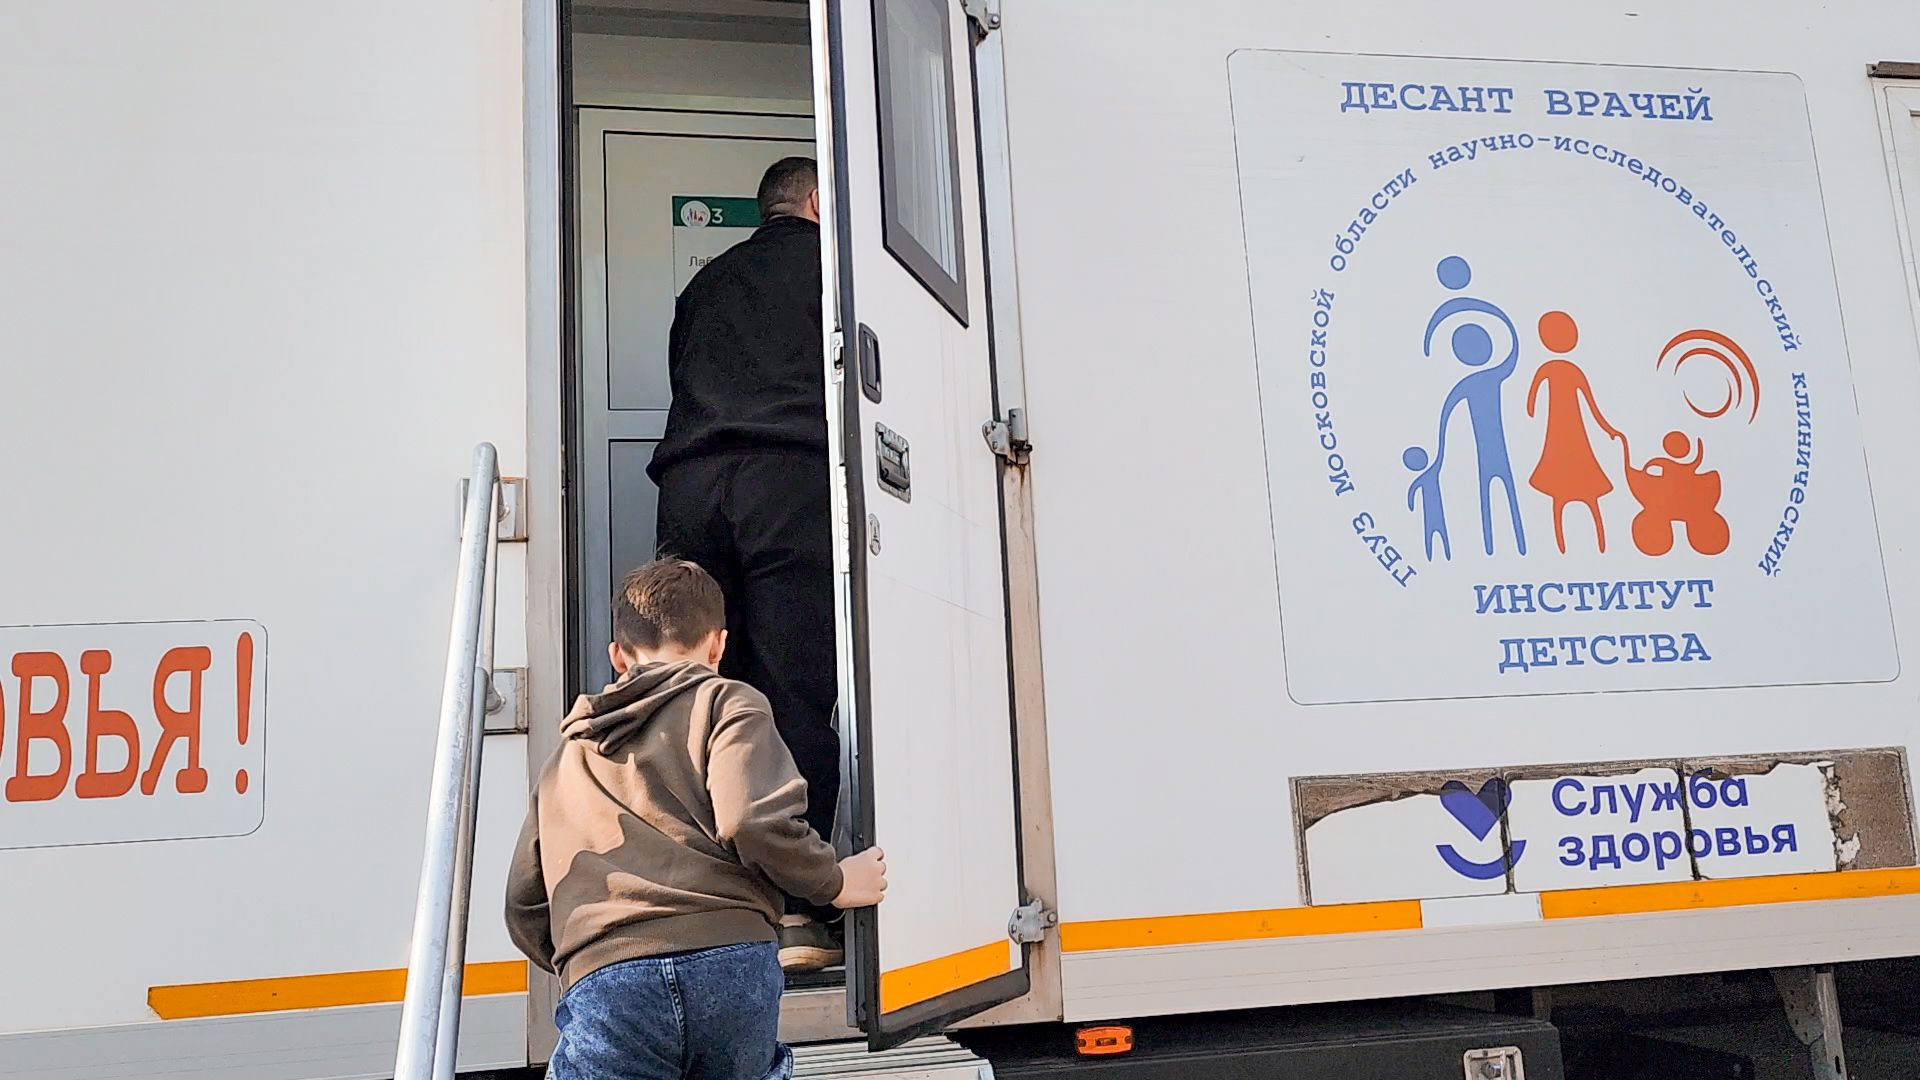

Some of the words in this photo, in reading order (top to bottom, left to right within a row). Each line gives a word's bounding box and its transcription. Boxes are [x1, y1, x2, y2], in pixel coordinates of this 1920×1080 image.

[1341, 81, 1514, 114] ДЕСАНТ
[1545, 87, 1712, 122] ВРАЧЕЙ
[711, 208, 723, 224] 3
[1330, 168, 1417, 272] области
[1428, 133, 1803, 352] научно-исследовательский
[1310, 288, 1355, 496] Московской
[1758, 372, 1812, 578] клинический
[1352, 511, 1417, 588] ГБУЗ
[1473, 578, 1715, 616] ИНСТИТУТ
[1498, 632, 1713, 674] ДЕТСТВА
[0, 631, 254, 803] ВЬЯ!
[1551, 767, 1749, 823] Служба
[1558, 823, 1798, 871] здоровья
